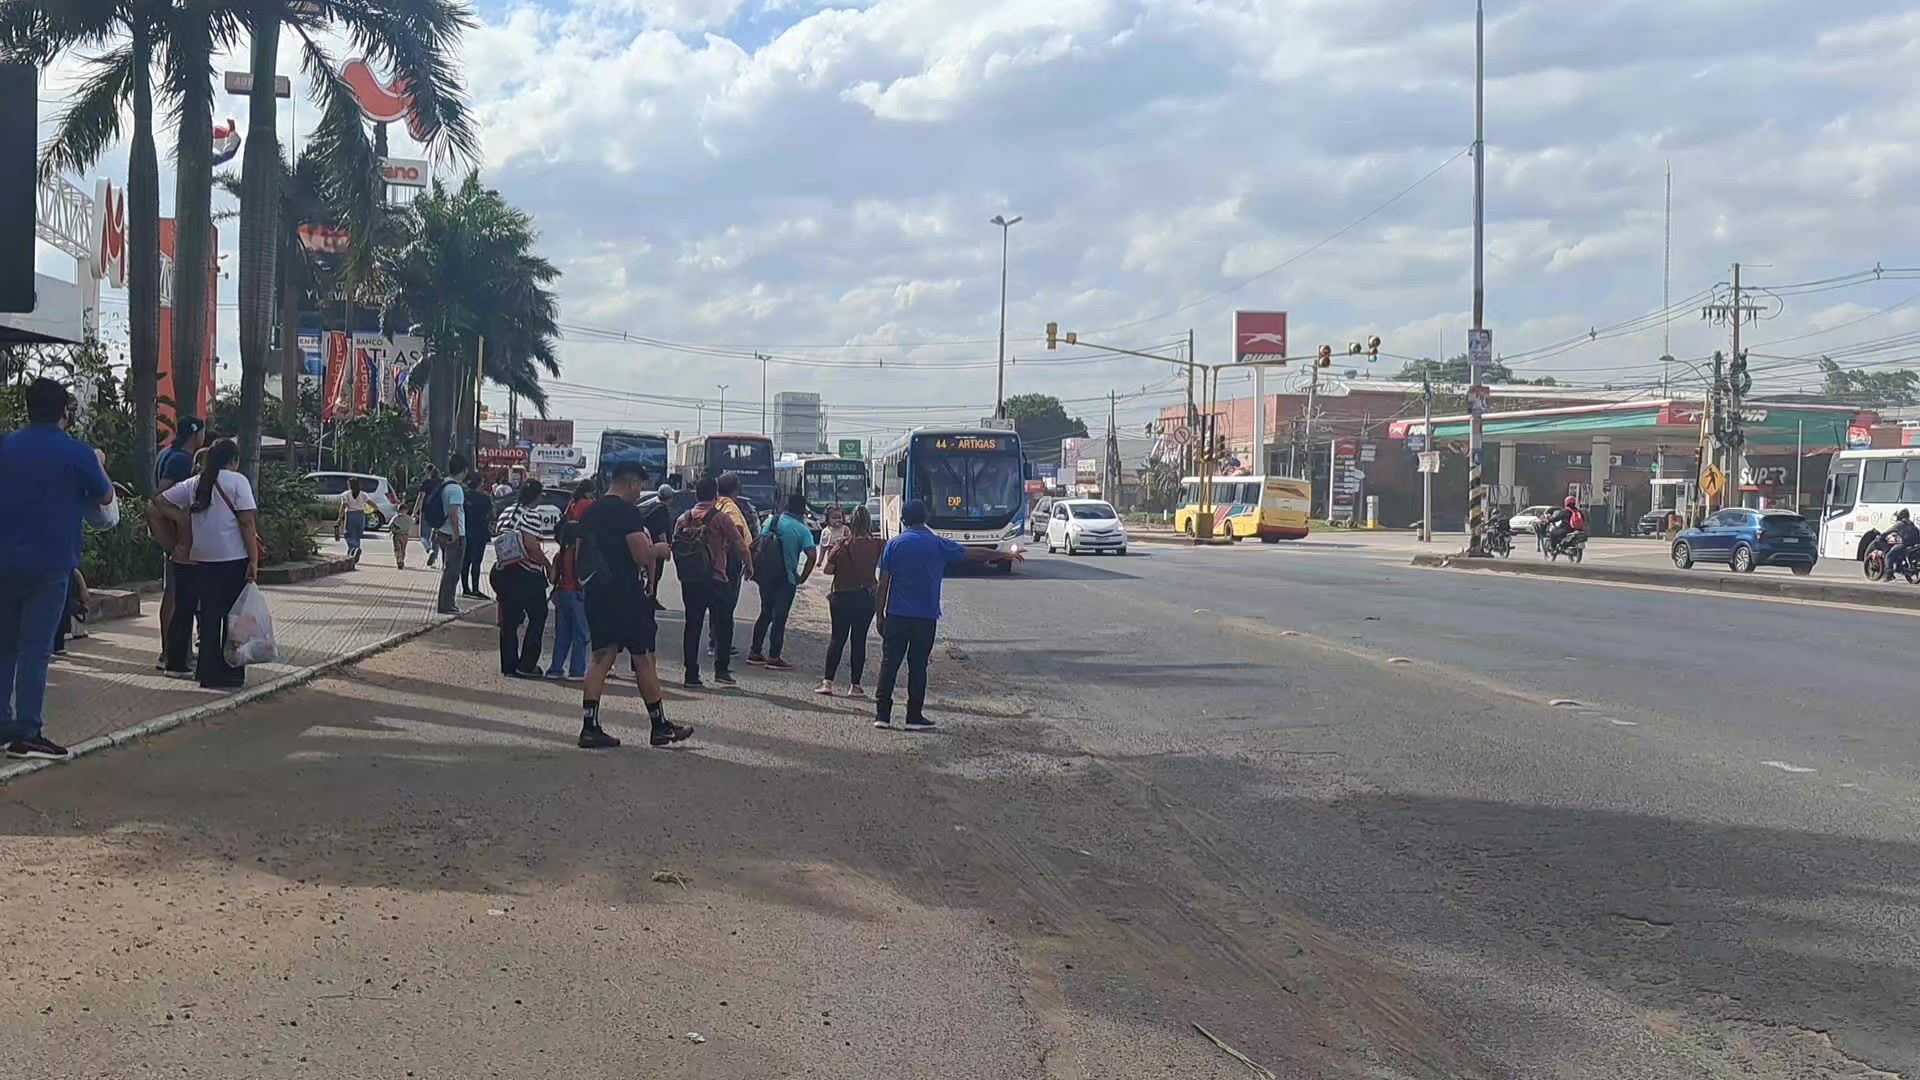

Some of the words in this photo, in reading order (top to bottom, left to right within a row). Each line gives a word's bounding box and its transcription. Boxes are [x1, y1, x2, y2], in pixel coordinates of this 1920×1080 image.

[356, 338, 384, 346] BANCO
[368, 348, 420, 366] TLAS
[935, 440, 947, 449] 44
[958, 440, 996, 449] ARTIGAS
[947, 496, 962, 506] EXP
